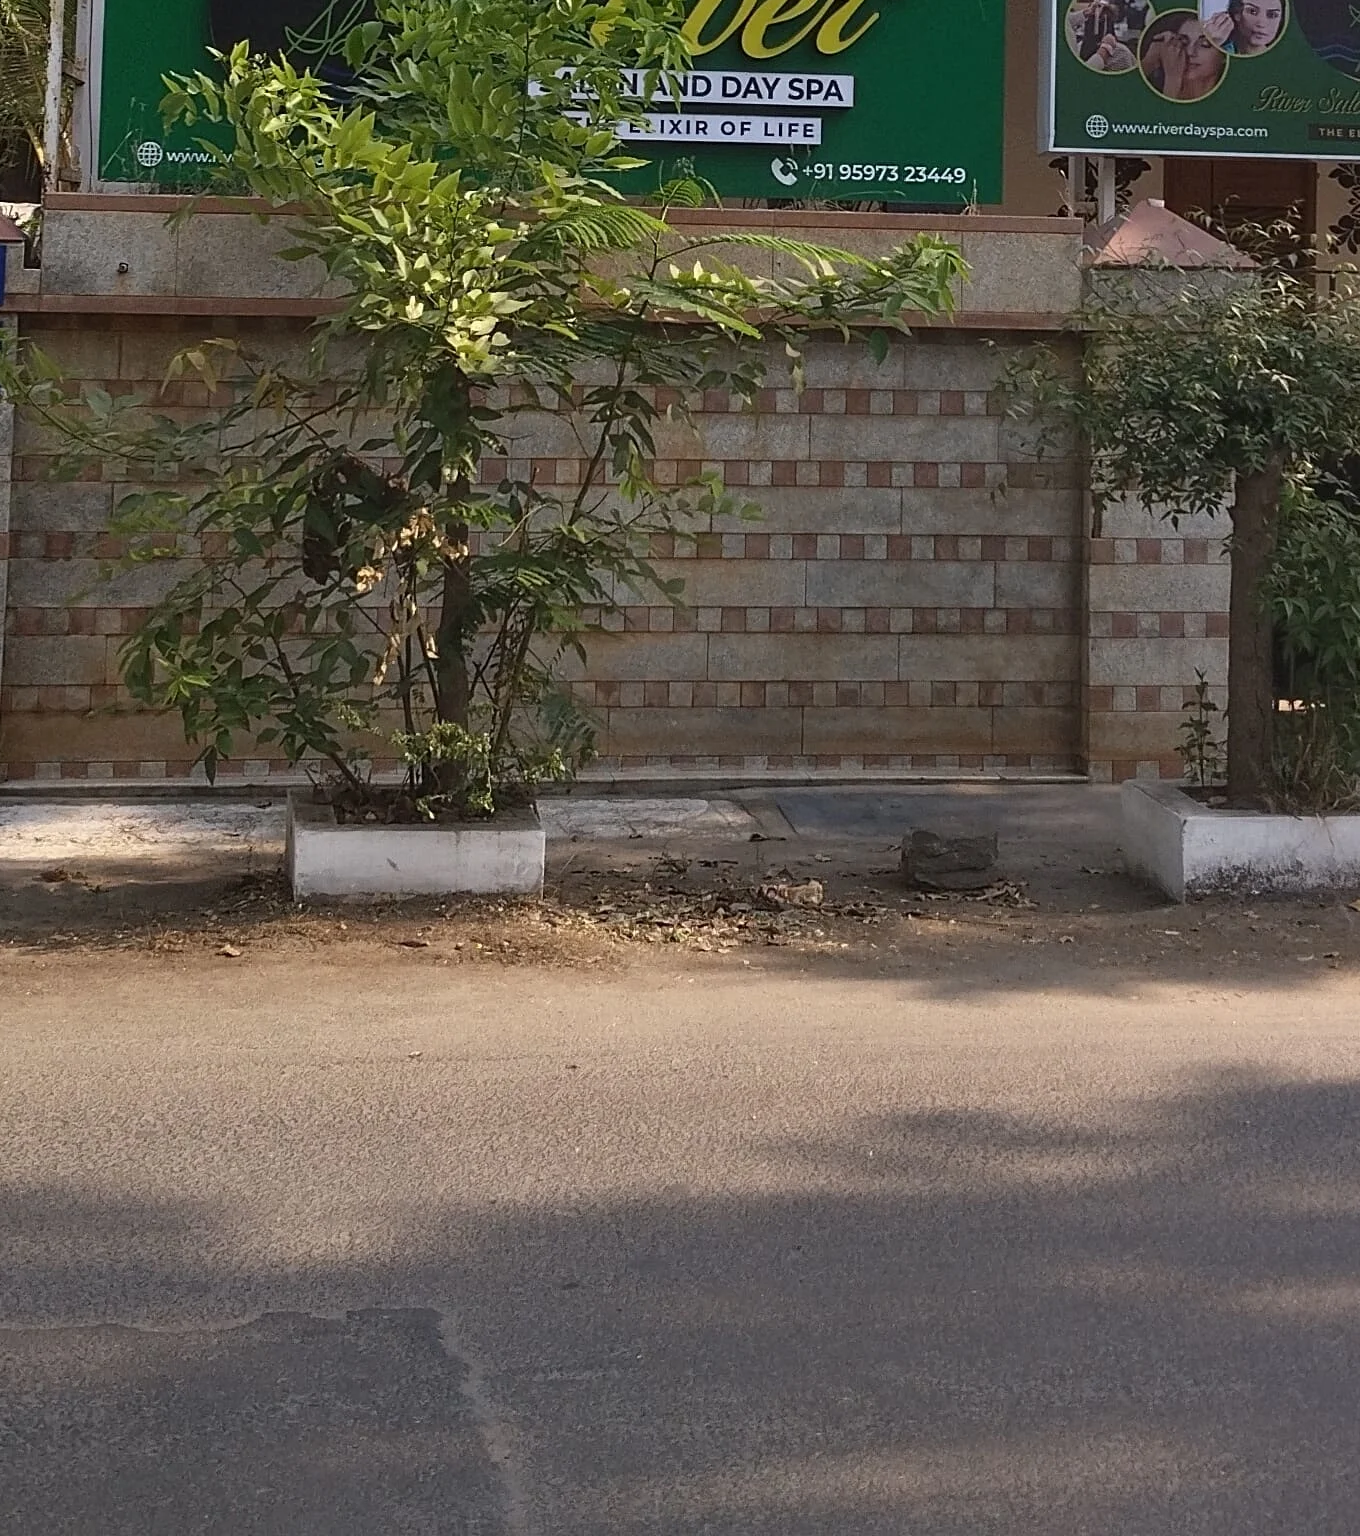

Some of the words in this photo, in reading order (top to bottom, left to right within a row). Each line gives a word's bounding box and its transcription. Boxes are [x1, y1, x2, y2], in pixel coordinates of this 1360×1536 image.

[721, 76, 781, 101] DAY
[788, 77, 844, 102] SPA
[1252, 85, 1312, 113] River
[629, 118, 708, 136] EIXIR
[721, 121, 752, 137] OF
[764, 122, 815, 138] LIFE
[1111, 121, 1268, 139] www.riverdayspa.com
[1318, 127, 1343, 137] THE
[803, 163, 833, 180] +91
[839, 164, 899, 182] 95973
[903, 166, 966, 184] 23449
